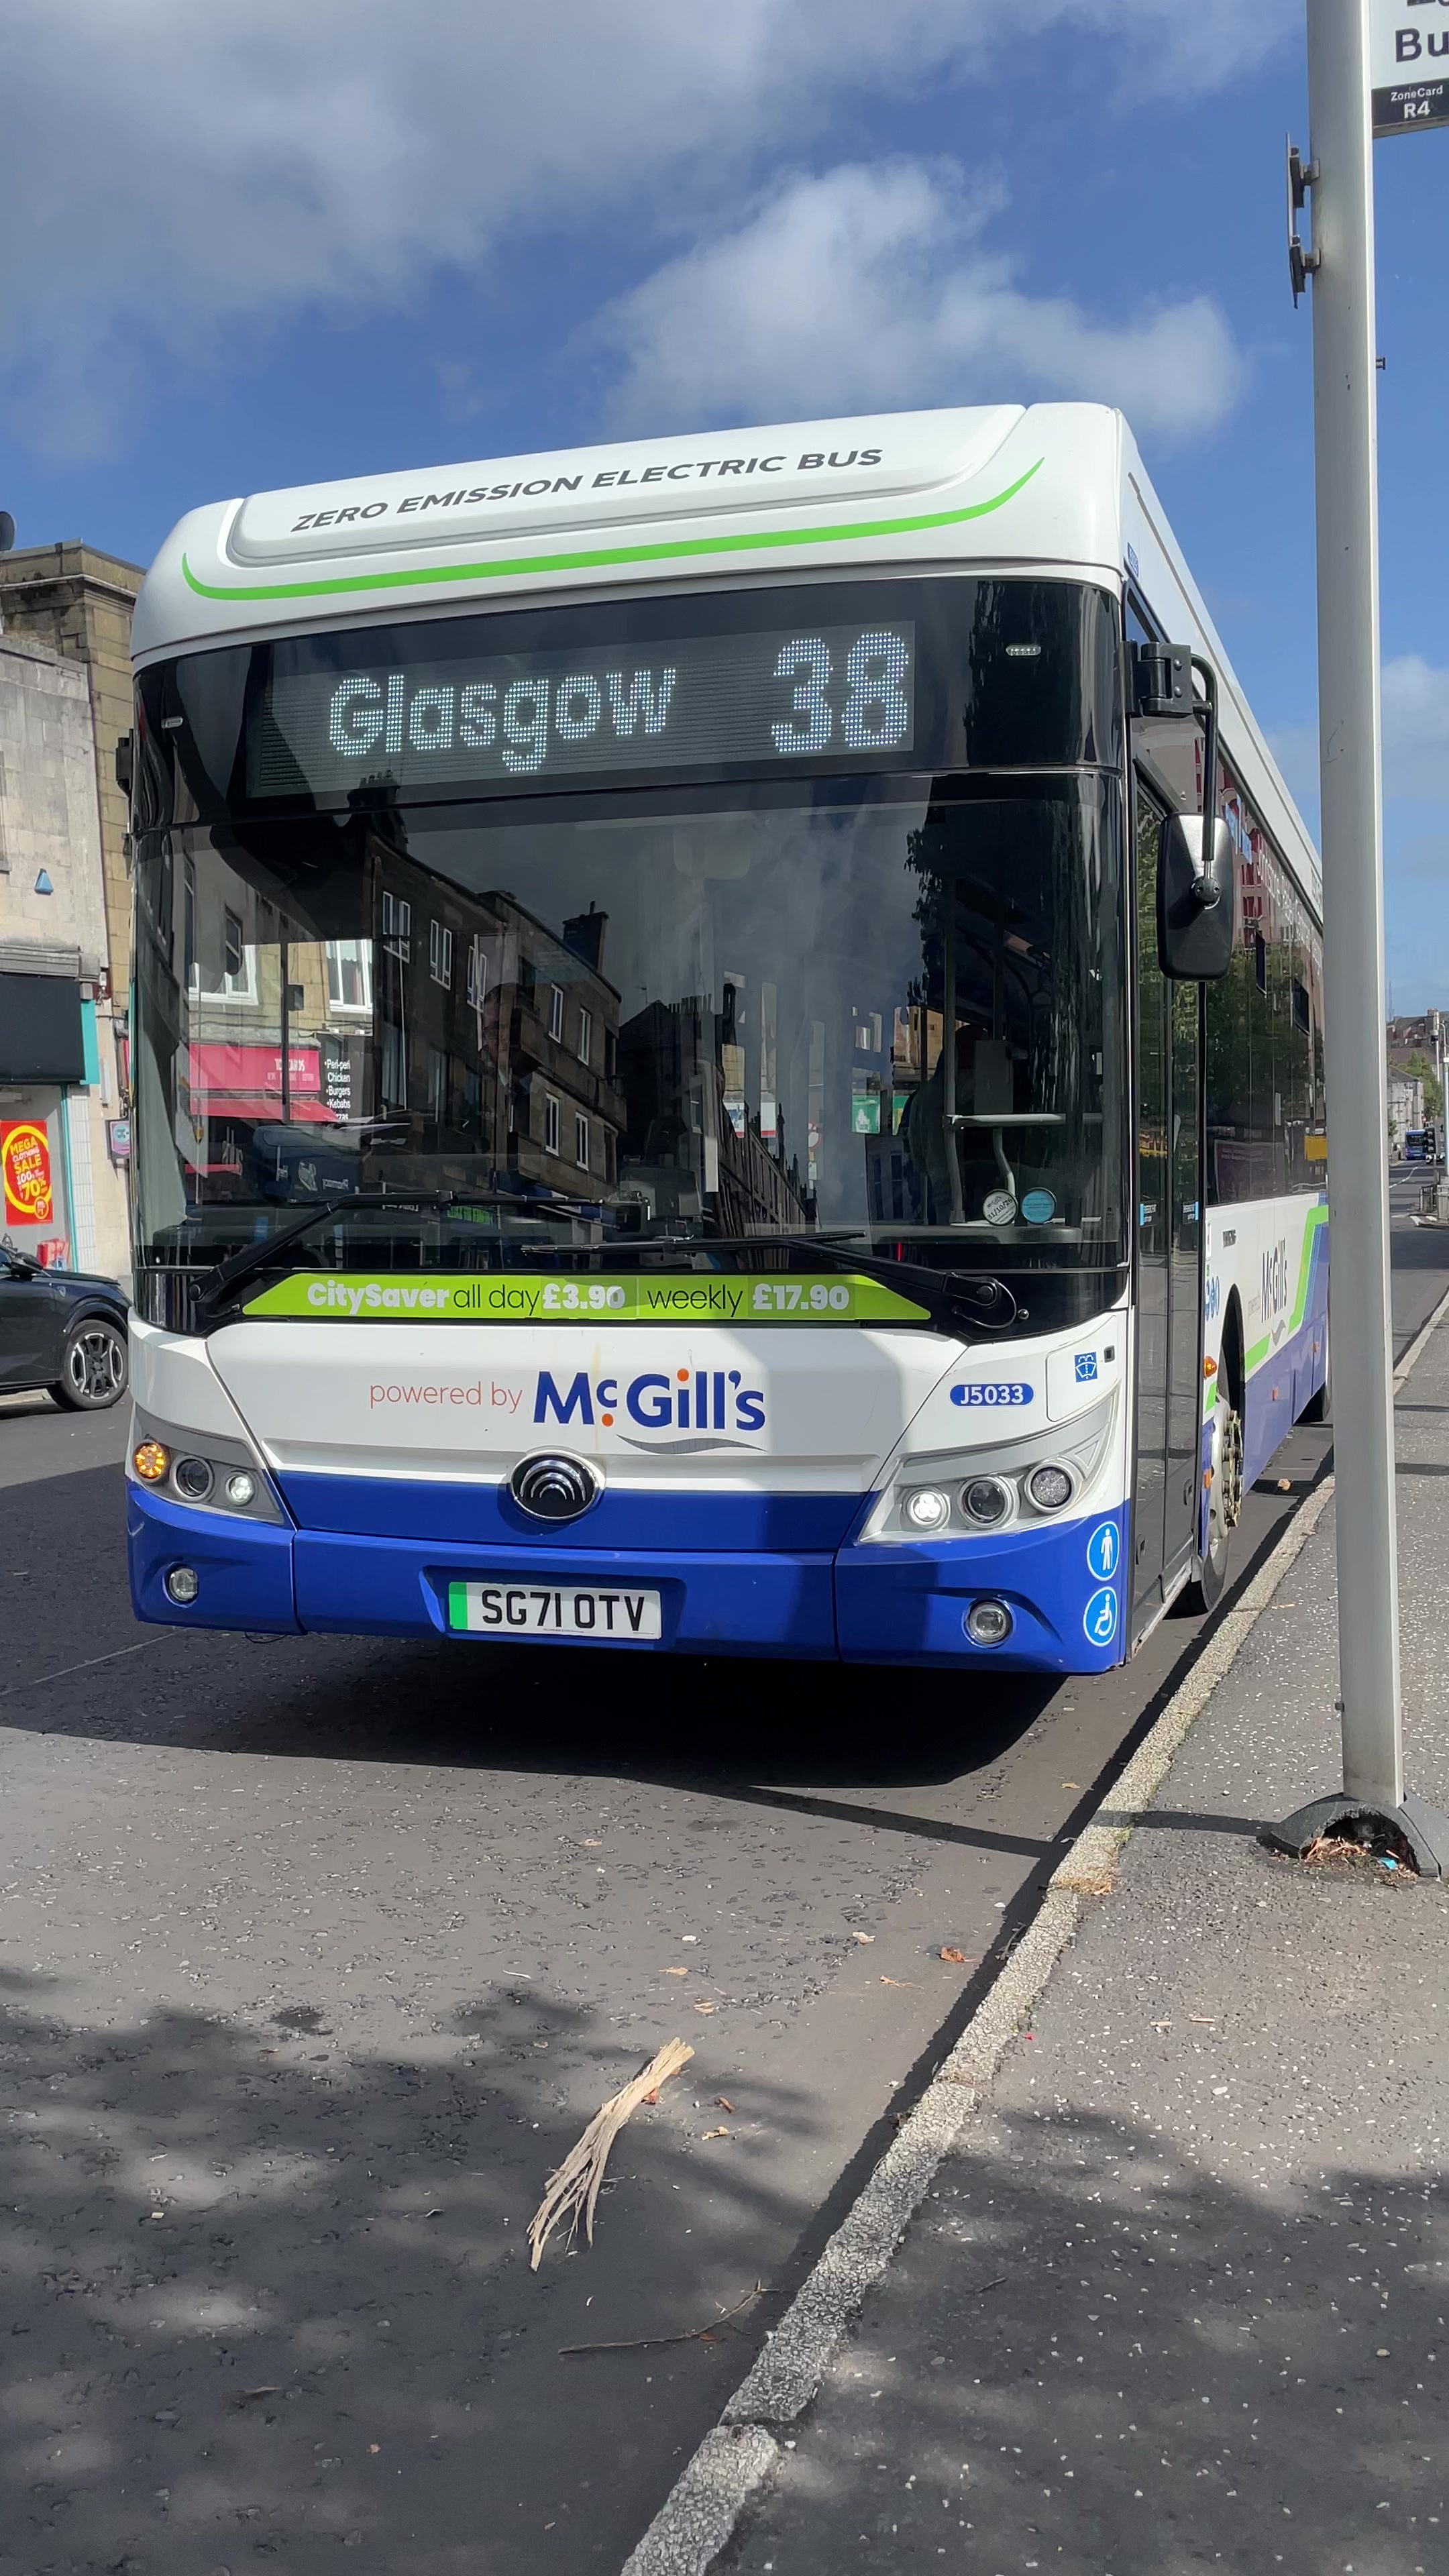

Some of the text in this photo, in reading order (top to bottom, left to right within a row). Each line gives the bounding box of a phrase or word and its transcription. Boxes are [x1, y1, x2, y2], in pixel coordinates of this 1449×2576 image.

[1390, 85, 1444, 102] ZoneCard
[1403, 100, 1431, 118] R4
[290, 449, 883, 532] ZERO EMISSION ELECTRIC BUS
[329, 631, 910, 772] Glasgow 38
[327, 1059, 351, 1071] Peri-peri
[327, 1072, 351, 1082] Chicken
[328, 1085, 351, 1098] Burgers
[329, 1099, 351, 1109] Kebabs
[10, 1136, 38, 1156] MEGA
[13, 1153, 42, 1175] SALE
[307, 1280, 850, 1317] CitySaver all day £3.90 weekly £17.90
[370, 1368, 766, 1431] powered by McGill's
[960, 1385, 1024, 1404] J5033
[482, 1589, 645, 1631] SG71 OTV
